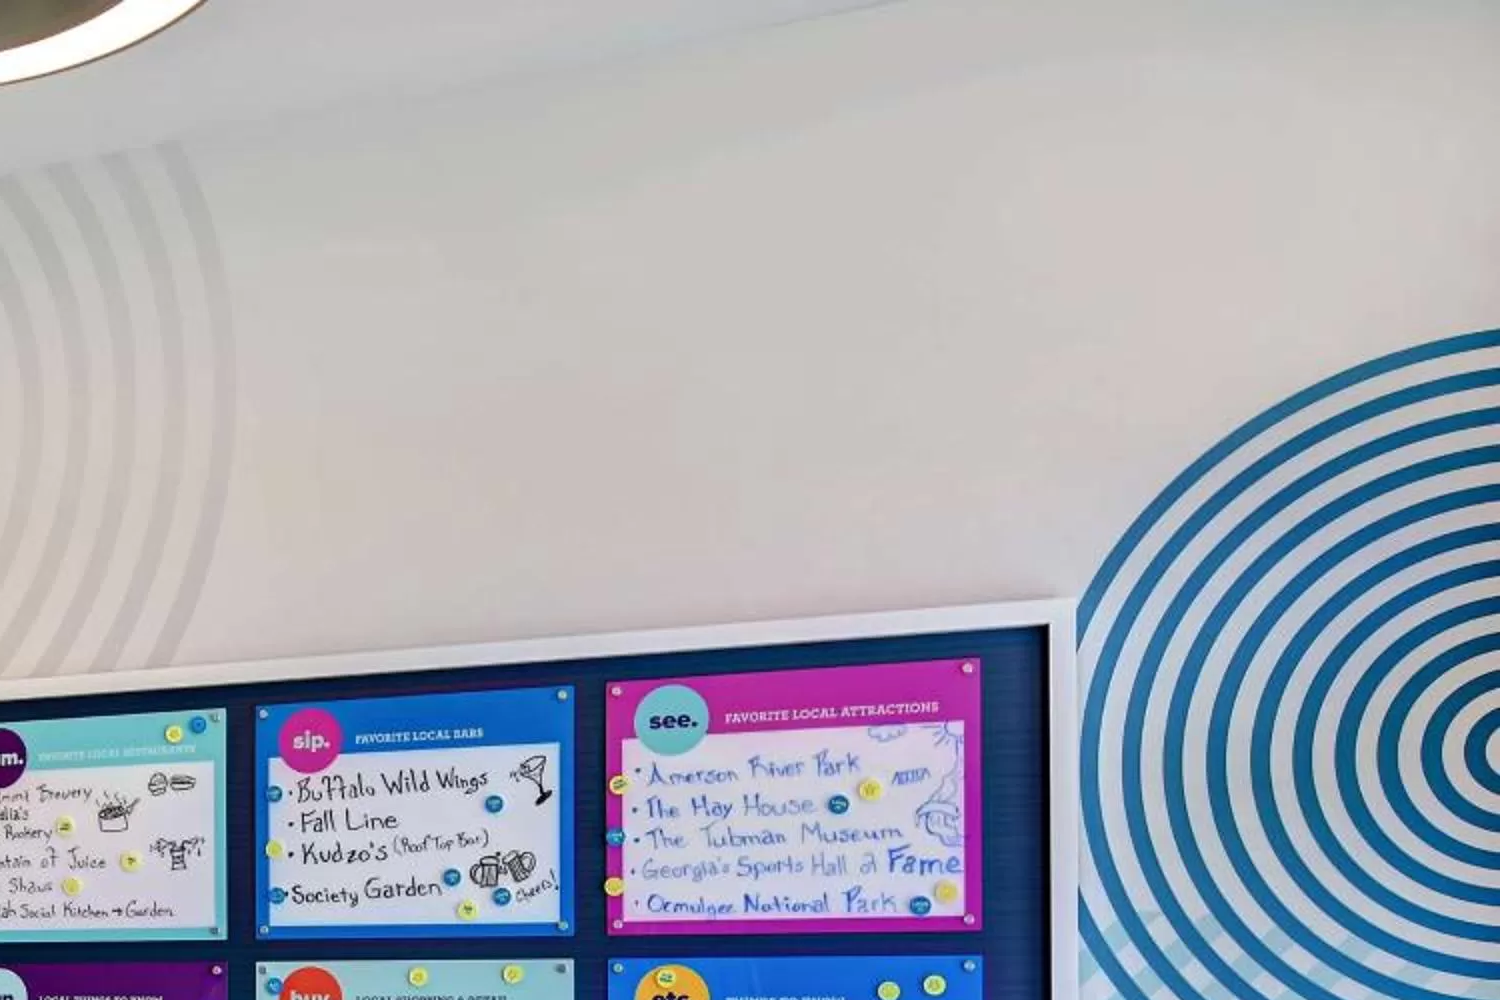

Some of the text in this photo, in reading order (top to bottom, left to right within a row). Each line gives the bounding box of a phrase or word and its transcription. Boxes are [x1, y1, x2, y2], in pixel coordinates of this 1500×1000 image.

[650, 712, 698, 730] see.
[725, 701, 940, 725] FAVORITE LOCAL ATTRACTIONS
[293, 730, 331, 752] sip.
[355, 727, 484, 745] FAVORITE LOCAL BARS
[647, 762, 739, 786] Amerson
[748, 755, 806, 783] River
[813, 748, 862, 775] Park
[296, 765, 489, 803] Buffalo Wild Wings
[646, 796, 679, 819] The
[742, 793, 818, 817] House
[300, 808, 399, 833] Fall Line
[646, 818, 904, 850] The Tubman Museum
[68, 847, 107, 870] Juice
[737, 857, 804, 881] Sports
[811, 852, 848, 876] Hall
[887, 843, 965, 876] Fame
[291, 876, 444, 908] Society Garden
[743, 889, 831, 914] National
[843, 885, 898, 914] Park
